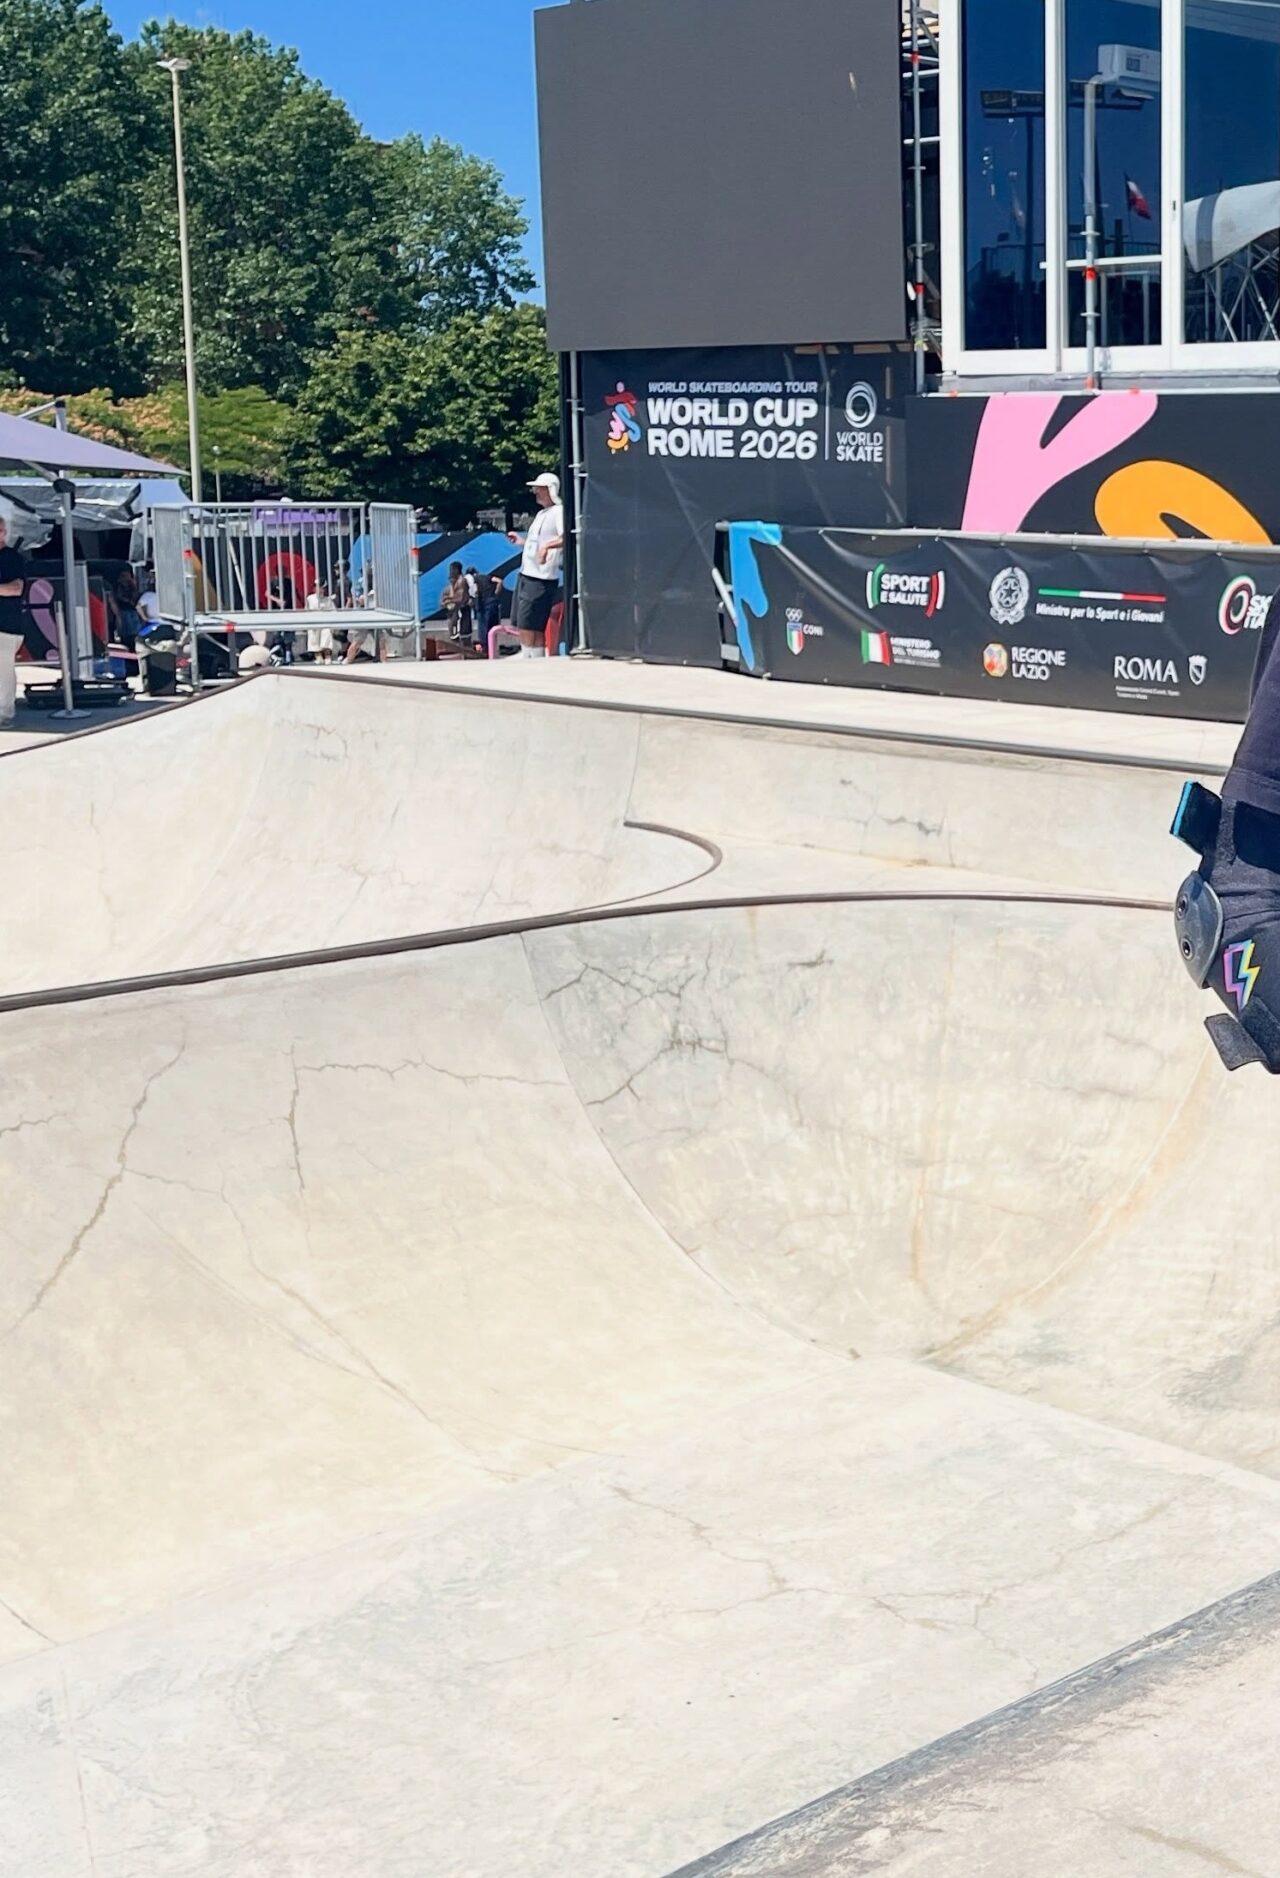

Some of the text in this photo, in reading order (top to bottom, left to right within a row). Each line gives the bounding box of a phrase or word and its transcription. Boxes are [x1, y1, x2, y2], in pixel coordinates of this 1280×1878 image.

[648, 381, 819, 394] WORLD SKATEBOARDING TOUR
[647, 396, 819, 428] WORLD CUP
[647, 427, 819, 460] ROME 2026
[836, 431, 884, 446] WORLD
[836, 446, 884, 462] SKATE
[881, 573, 930, 592] SPORT
[880, 590, 929, 606] E SALUTE
[1036, 602, 1071, 618] Ministro
[1070, 606, 1086, 620] per
[1086, 605, 1095, 619] lo
[1095, 606, 1119, 622] Sport
[1131, 608, 1165, 624] Giovani
[803, 623, 824, 637] CONI
[890, 636, 933, 650] MINISTERO
[1011, 646, 1066, 666] REGIONE
[1011, 662, 1050, 681] LAZIO
[1114, 655, 1178, 684] ROMA
